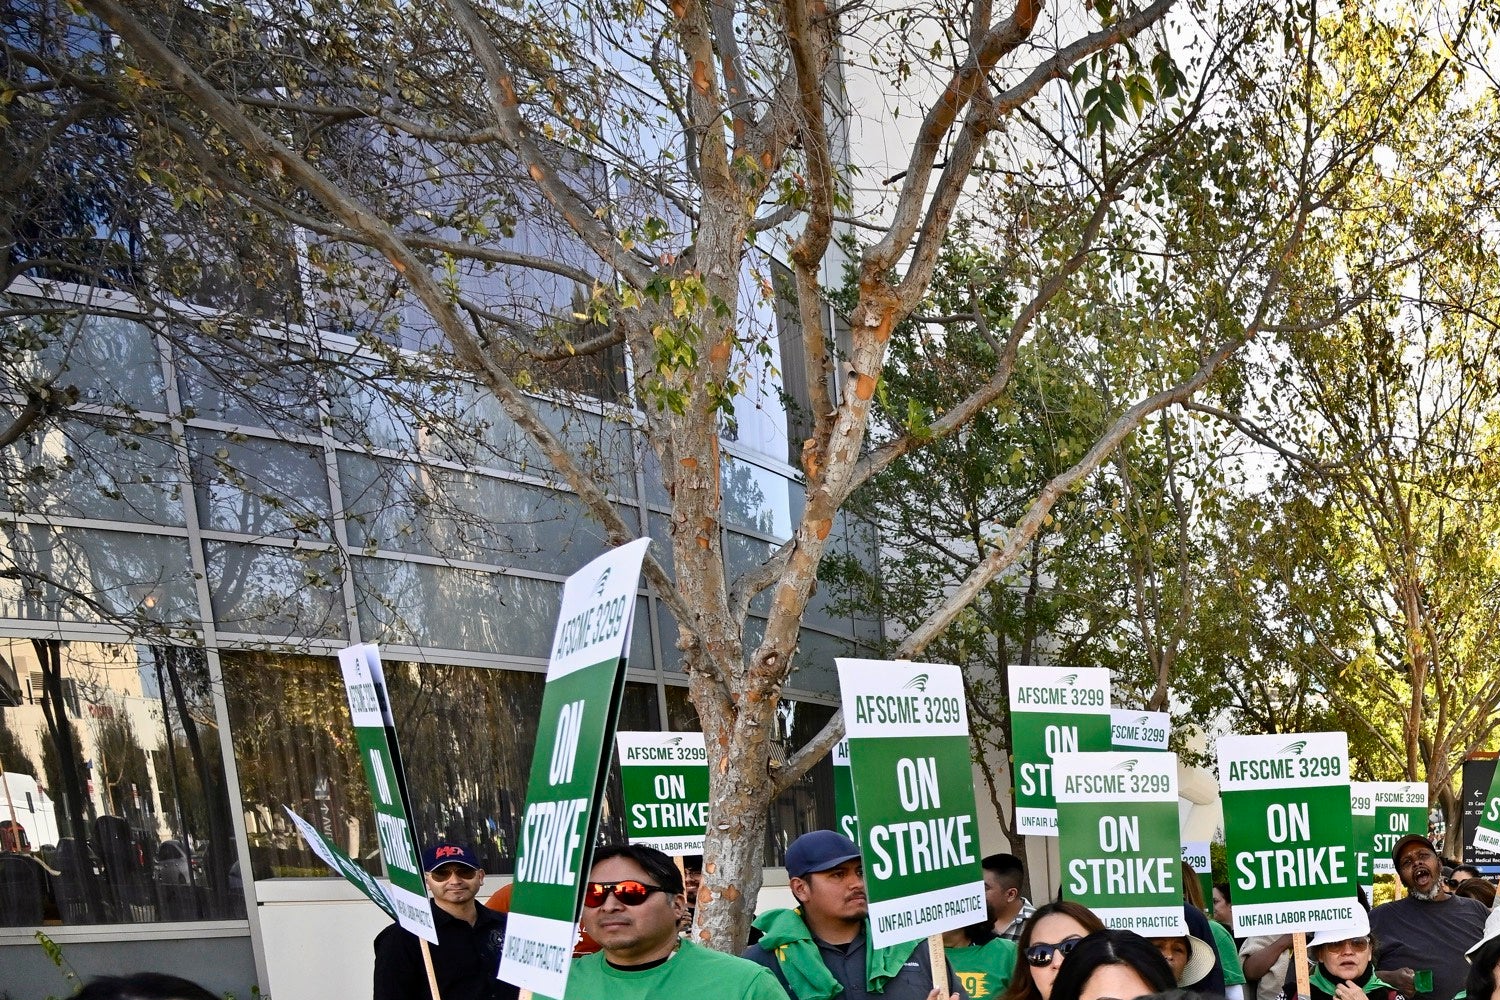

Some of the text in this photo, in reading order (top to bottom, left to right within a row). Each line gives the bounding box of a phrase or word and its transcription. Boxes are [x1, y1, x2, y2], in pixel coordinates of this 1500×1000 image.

[556, 594, 626, 661] AFSCME 3299
[856, 695, 960, 724] AFSCME 3299
[1018, 686, 1104, 706] AFSCME 3299
[549, 700, 585, 786] ON
[1045, 725, 1078, 757] ON
[1111, 724, 1165, 742] FSCME 3299
[627, 747, 705, 760] AFSCME 3299
[369, 748, 392, 805] ON
[1230, 757, 1340, 781] AFSCME 3299
[654, 775, 685, 800] ON
[896, 757, 940, 812] ON
[1065, 775, 1126, 794] AFSCME
[1130, 775, 1170, 793] 3299
[1375, 793, 1425, 803] AFSCME 3299
[632, 802, 708, 829] STRIKE
[1352, 797, 1371, 810] 299
[1022, 816, 1048, 827] UNFAIR
[1098, 815, 1140, 852] ON
[1266, 803, 1310, 843] ON
[1389, 813, 1409, 831] ON
[378, 812, 418, 875] STRIKE
[518, 798, 588, 886] STRIKE
[684, 841, 704, 849] PRACT
[869, 815, 975, 881] STRIKE
[1478, 834, 1499, 846] UNFAIR
[1068, 858, 1175, 895] STRIKE
[1236, 846, 1348, 891] STRIKE
[878, 895, 982, 933] UNFAIR LABOR PRACTICE
[1104, 914, 1179, 929] LABOR PRACTICE
[1239, 907, 1352, 927] UNFAIR LABOR PRACTICE
